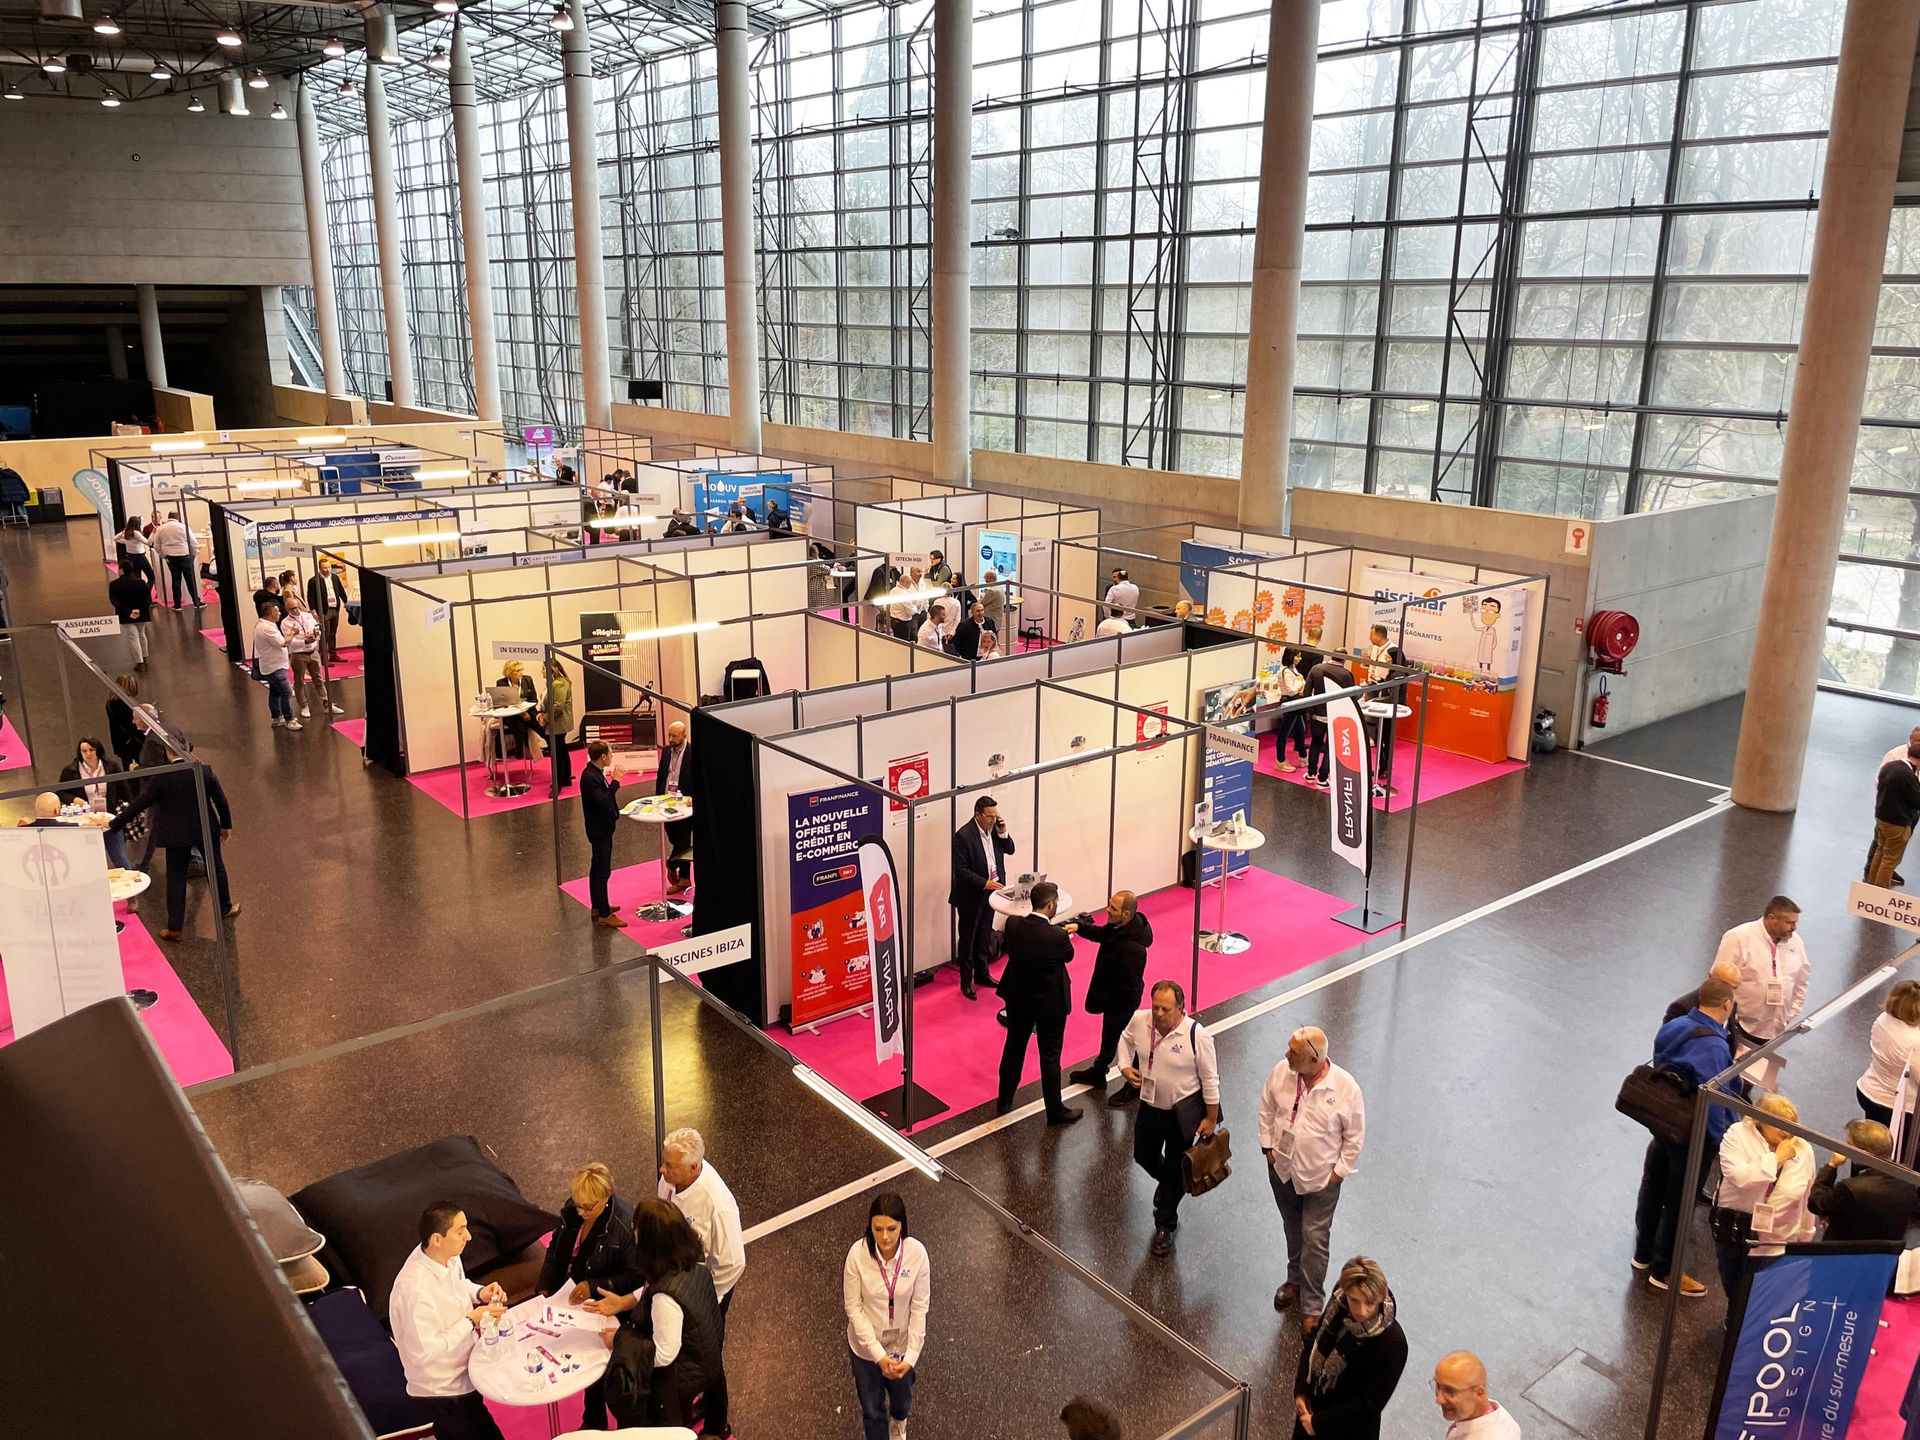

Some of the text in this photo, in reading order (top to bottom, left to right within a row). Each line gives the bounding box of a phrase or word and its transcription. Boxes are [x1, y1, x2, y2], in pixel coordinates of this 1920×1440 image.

[64, 618, 113, 628] ASSURANCES
[1404, 630, 1443, 642] GAGNANTES
[1209, 733, 1255, 753] FRANFINANCE
[820, 791, 860, 803] FRANFINANCE
[795, 806, 869, 828] LA NOUVELLE
[795, 820, 848, 839] OFFRE DE
[795, 830, 852, 850] CRÉDIT EN
[796, 840, 859, 862] E-COMMERC
[816, 872, 838, 882] FRANFI
[1857, 900, 1920, 927] POOL DESI
[1888, 897, 1913, 911] APF
[716, 938, 745, 954] IBIZA
[1747, 1302, 1800, 1417] POOL
[1778, 1300, 1817, 1417] DESIGN
[1830, 1311, 1858, 1398] sur-mesure
[1823, 1402, 1839, 1422] du
